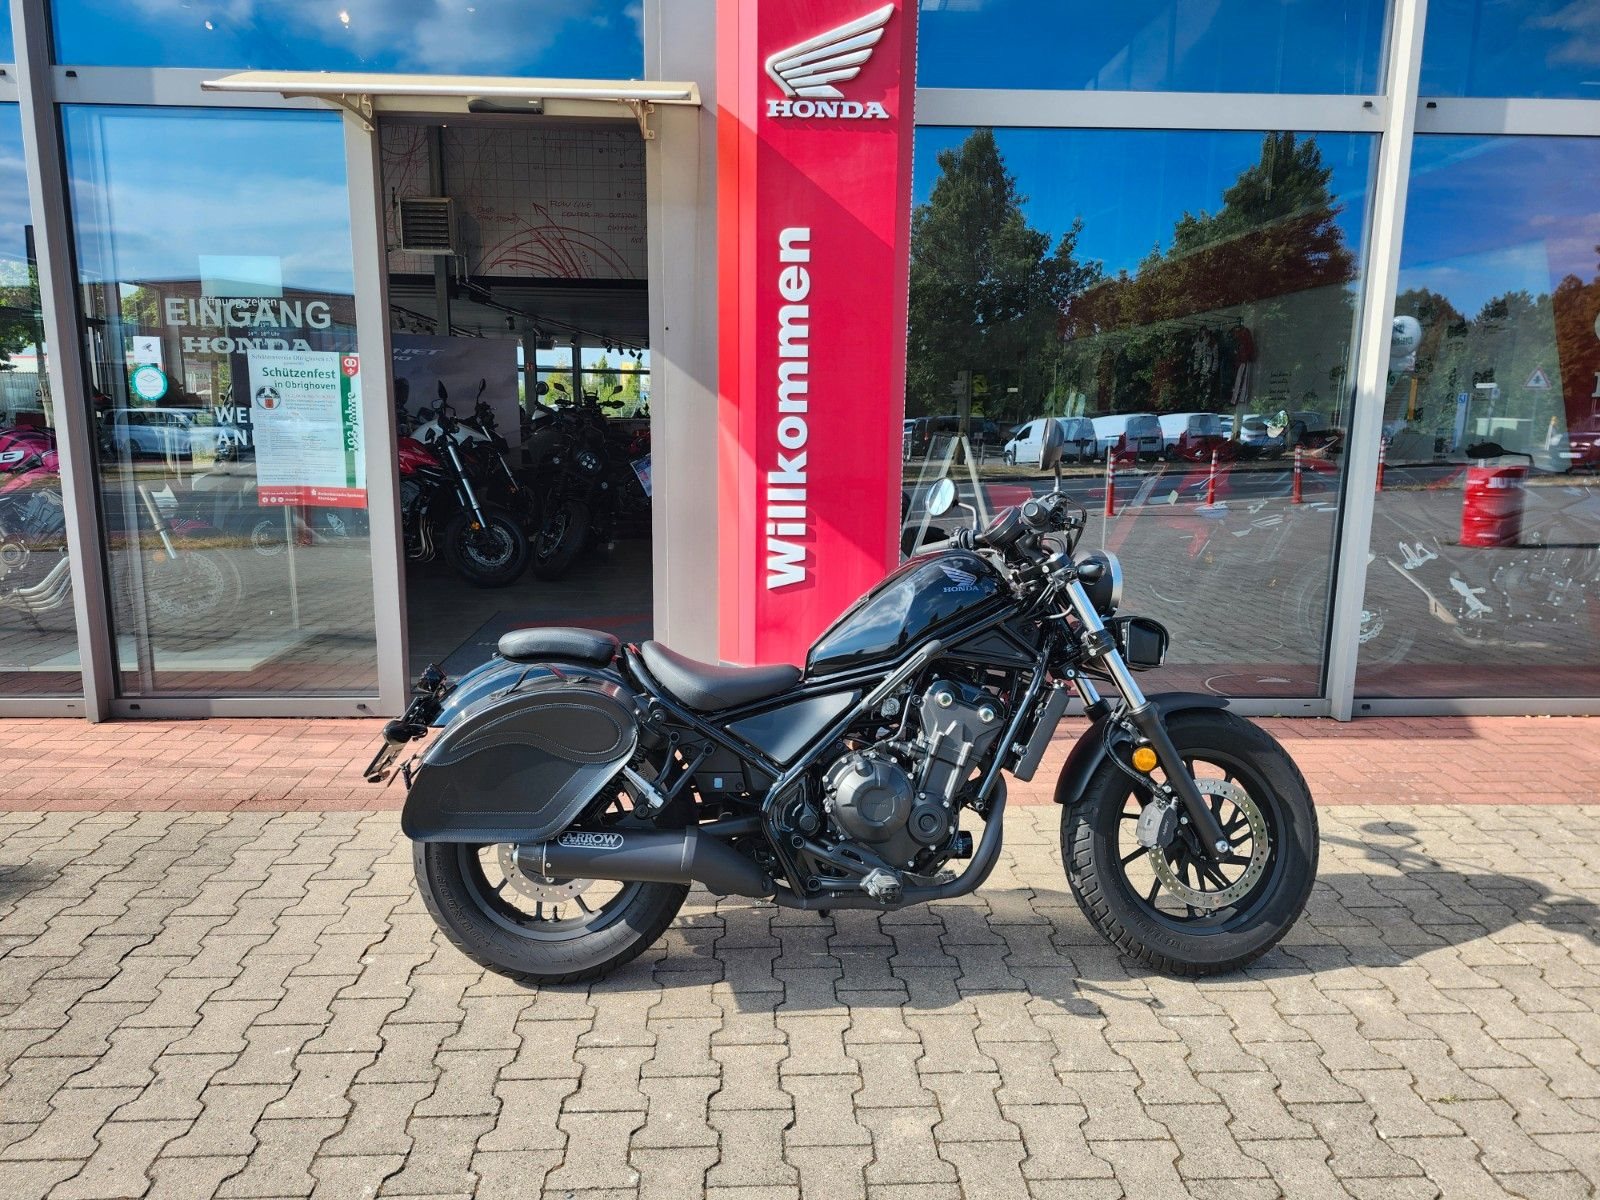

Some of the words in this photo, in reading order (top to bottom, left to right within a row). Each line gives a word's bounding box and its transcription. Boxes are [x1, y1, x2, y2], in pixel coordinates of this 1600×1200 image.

[766, 99, 889, 119] HONDA
[164, 298, 332, 329] EINGANG
[182, 336, 313, 354] HONDA
[262, 367, 336, 379] Schützenfest
[274, 380, 283, 388] in
[285, 381, 336, 391] Obrighoven
[345, 392, 359, 426] Jahre
[766, 227, 811, 590] Willkommen
[943, 585, 979, 593] HONDA
[562, 832, 619, 844] ARROW
